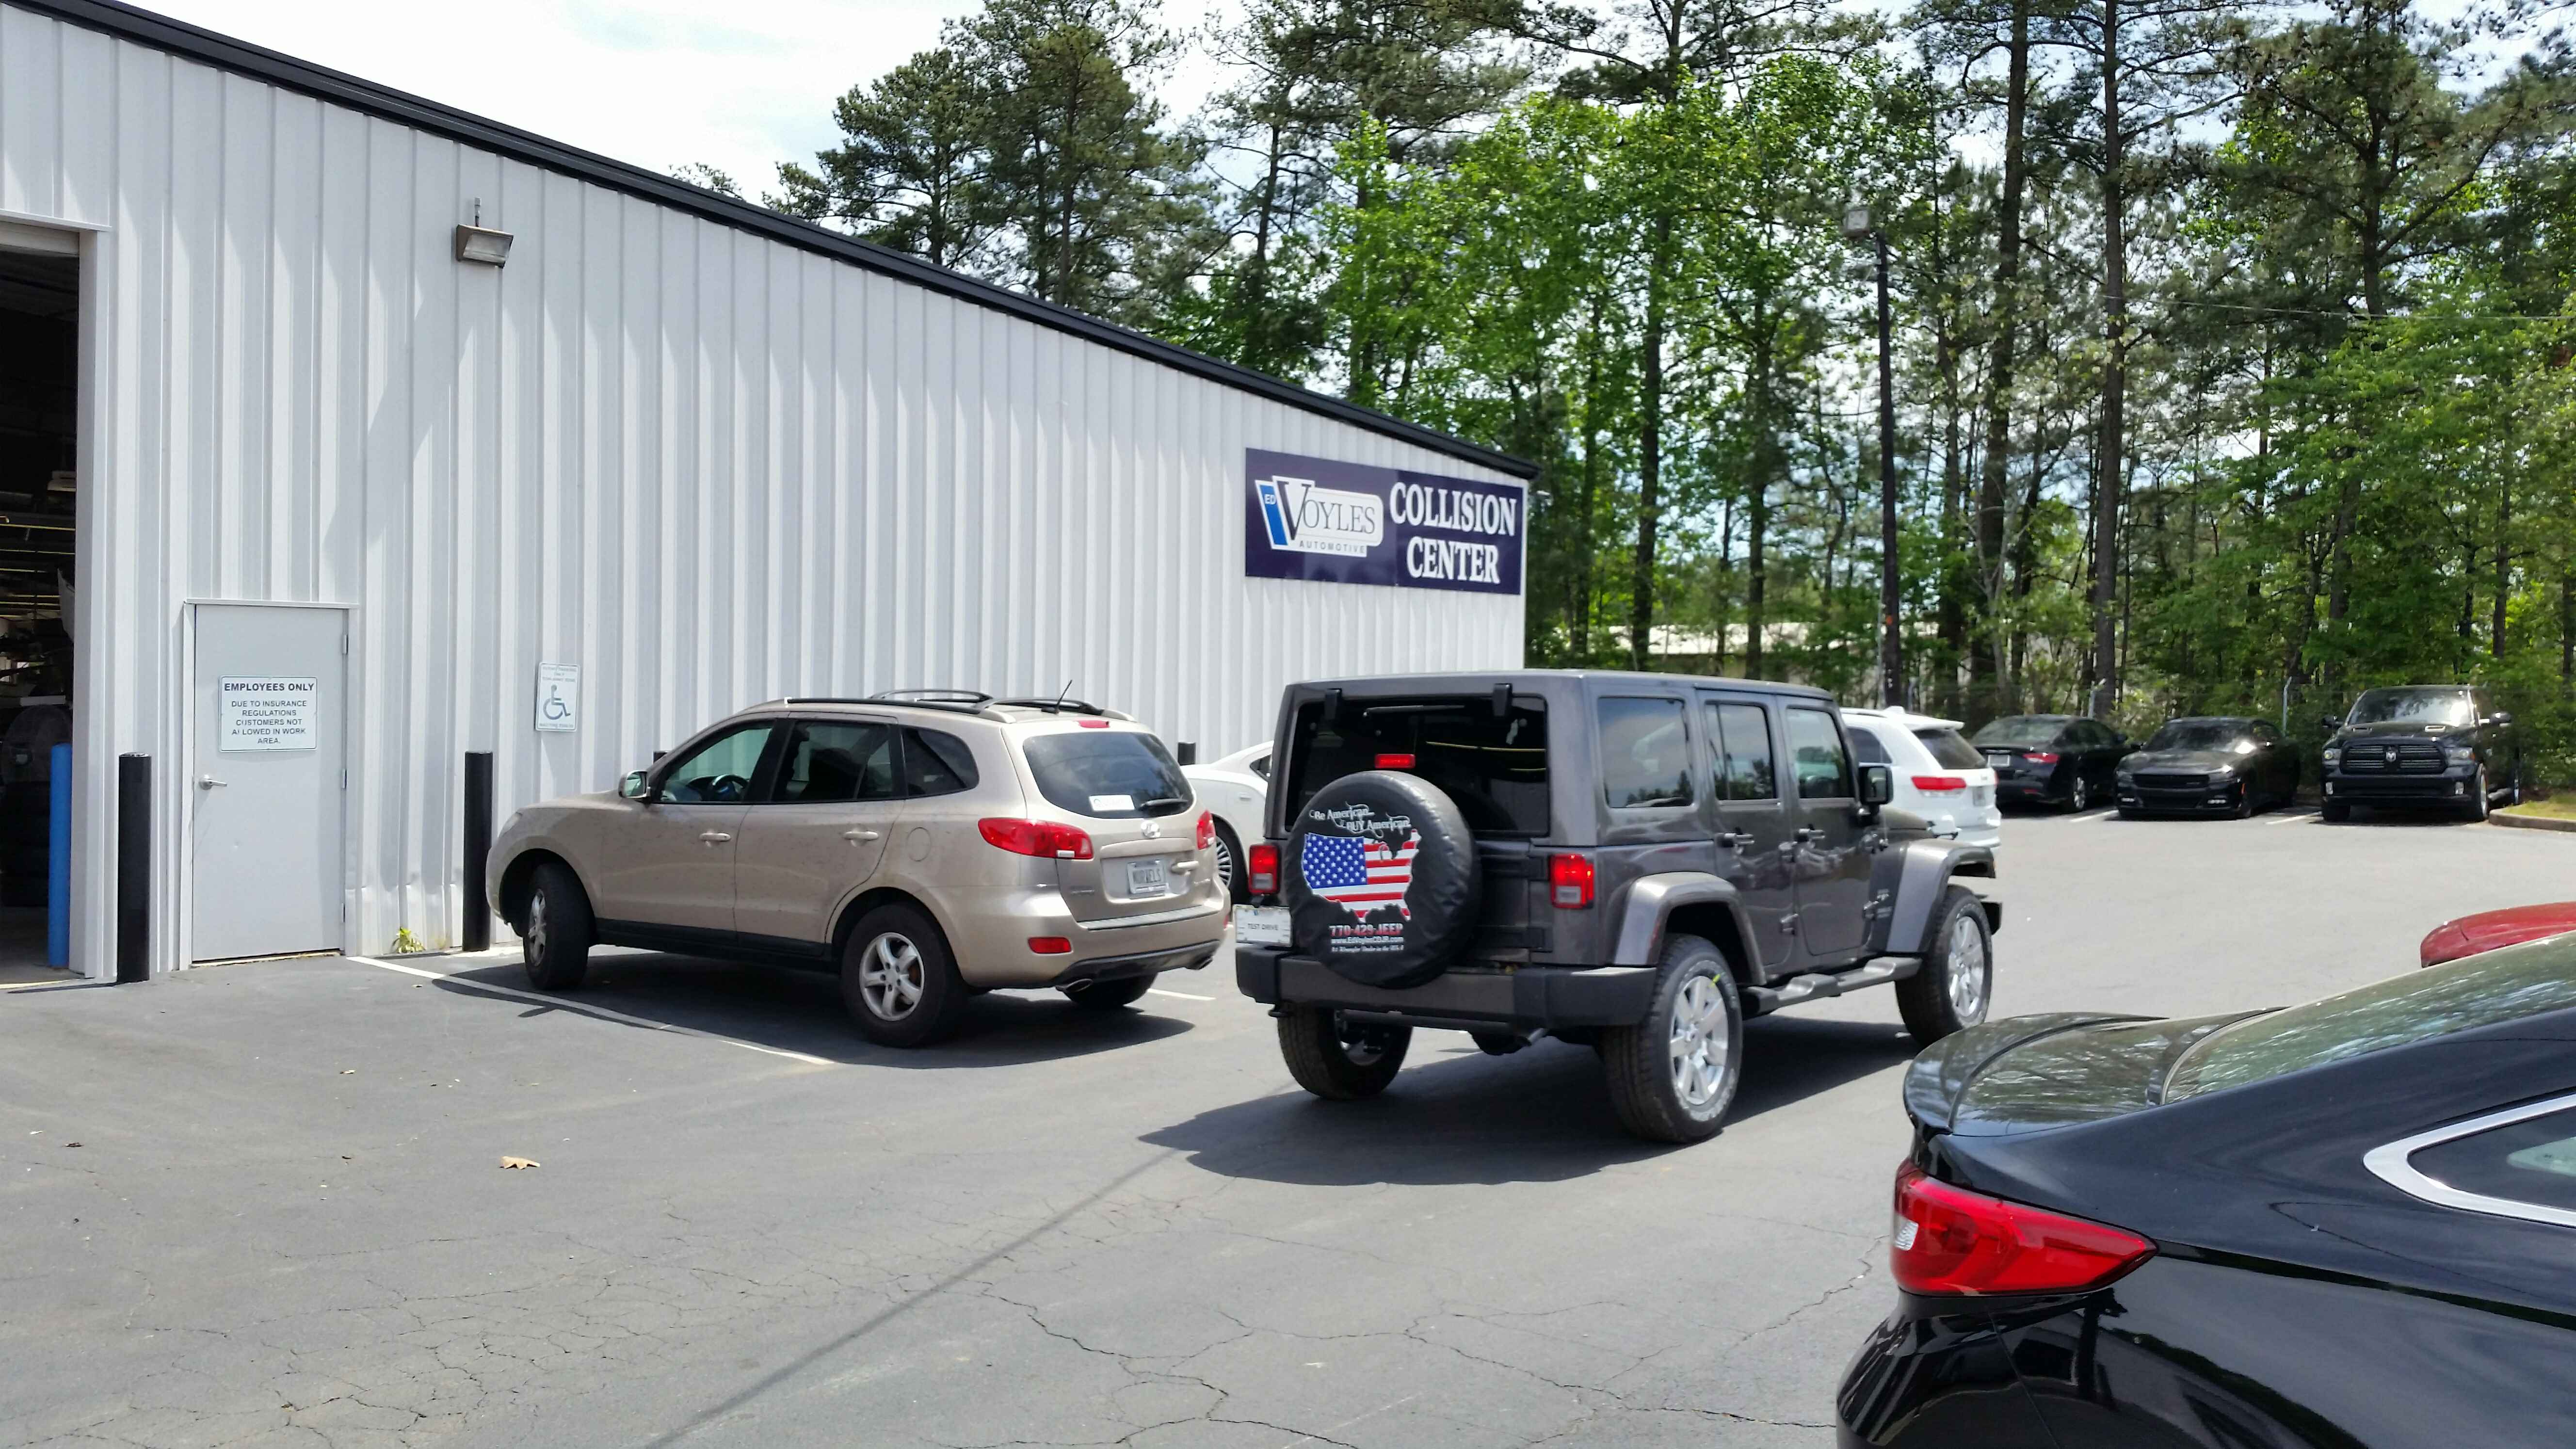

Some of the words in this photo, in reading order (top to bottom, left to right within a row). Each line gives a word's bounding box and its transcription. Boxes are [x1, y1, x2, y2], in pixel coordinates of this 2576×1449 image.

[1264, 493, 1276, 505] ED
[1276, 481, 1376, 540] VOYLES
[1389, 482, 1516, 536] COLLISION
[1299, 540, 1366, 554] AUTOMOTIVE
[1407, 536, 1500, 584] CENTER
[224, 683, 285, 691] EMPLOYEES
[288, 683, 314, 691] ONLY
[1329, 923, 1403, 936] 770-429-JEEP
